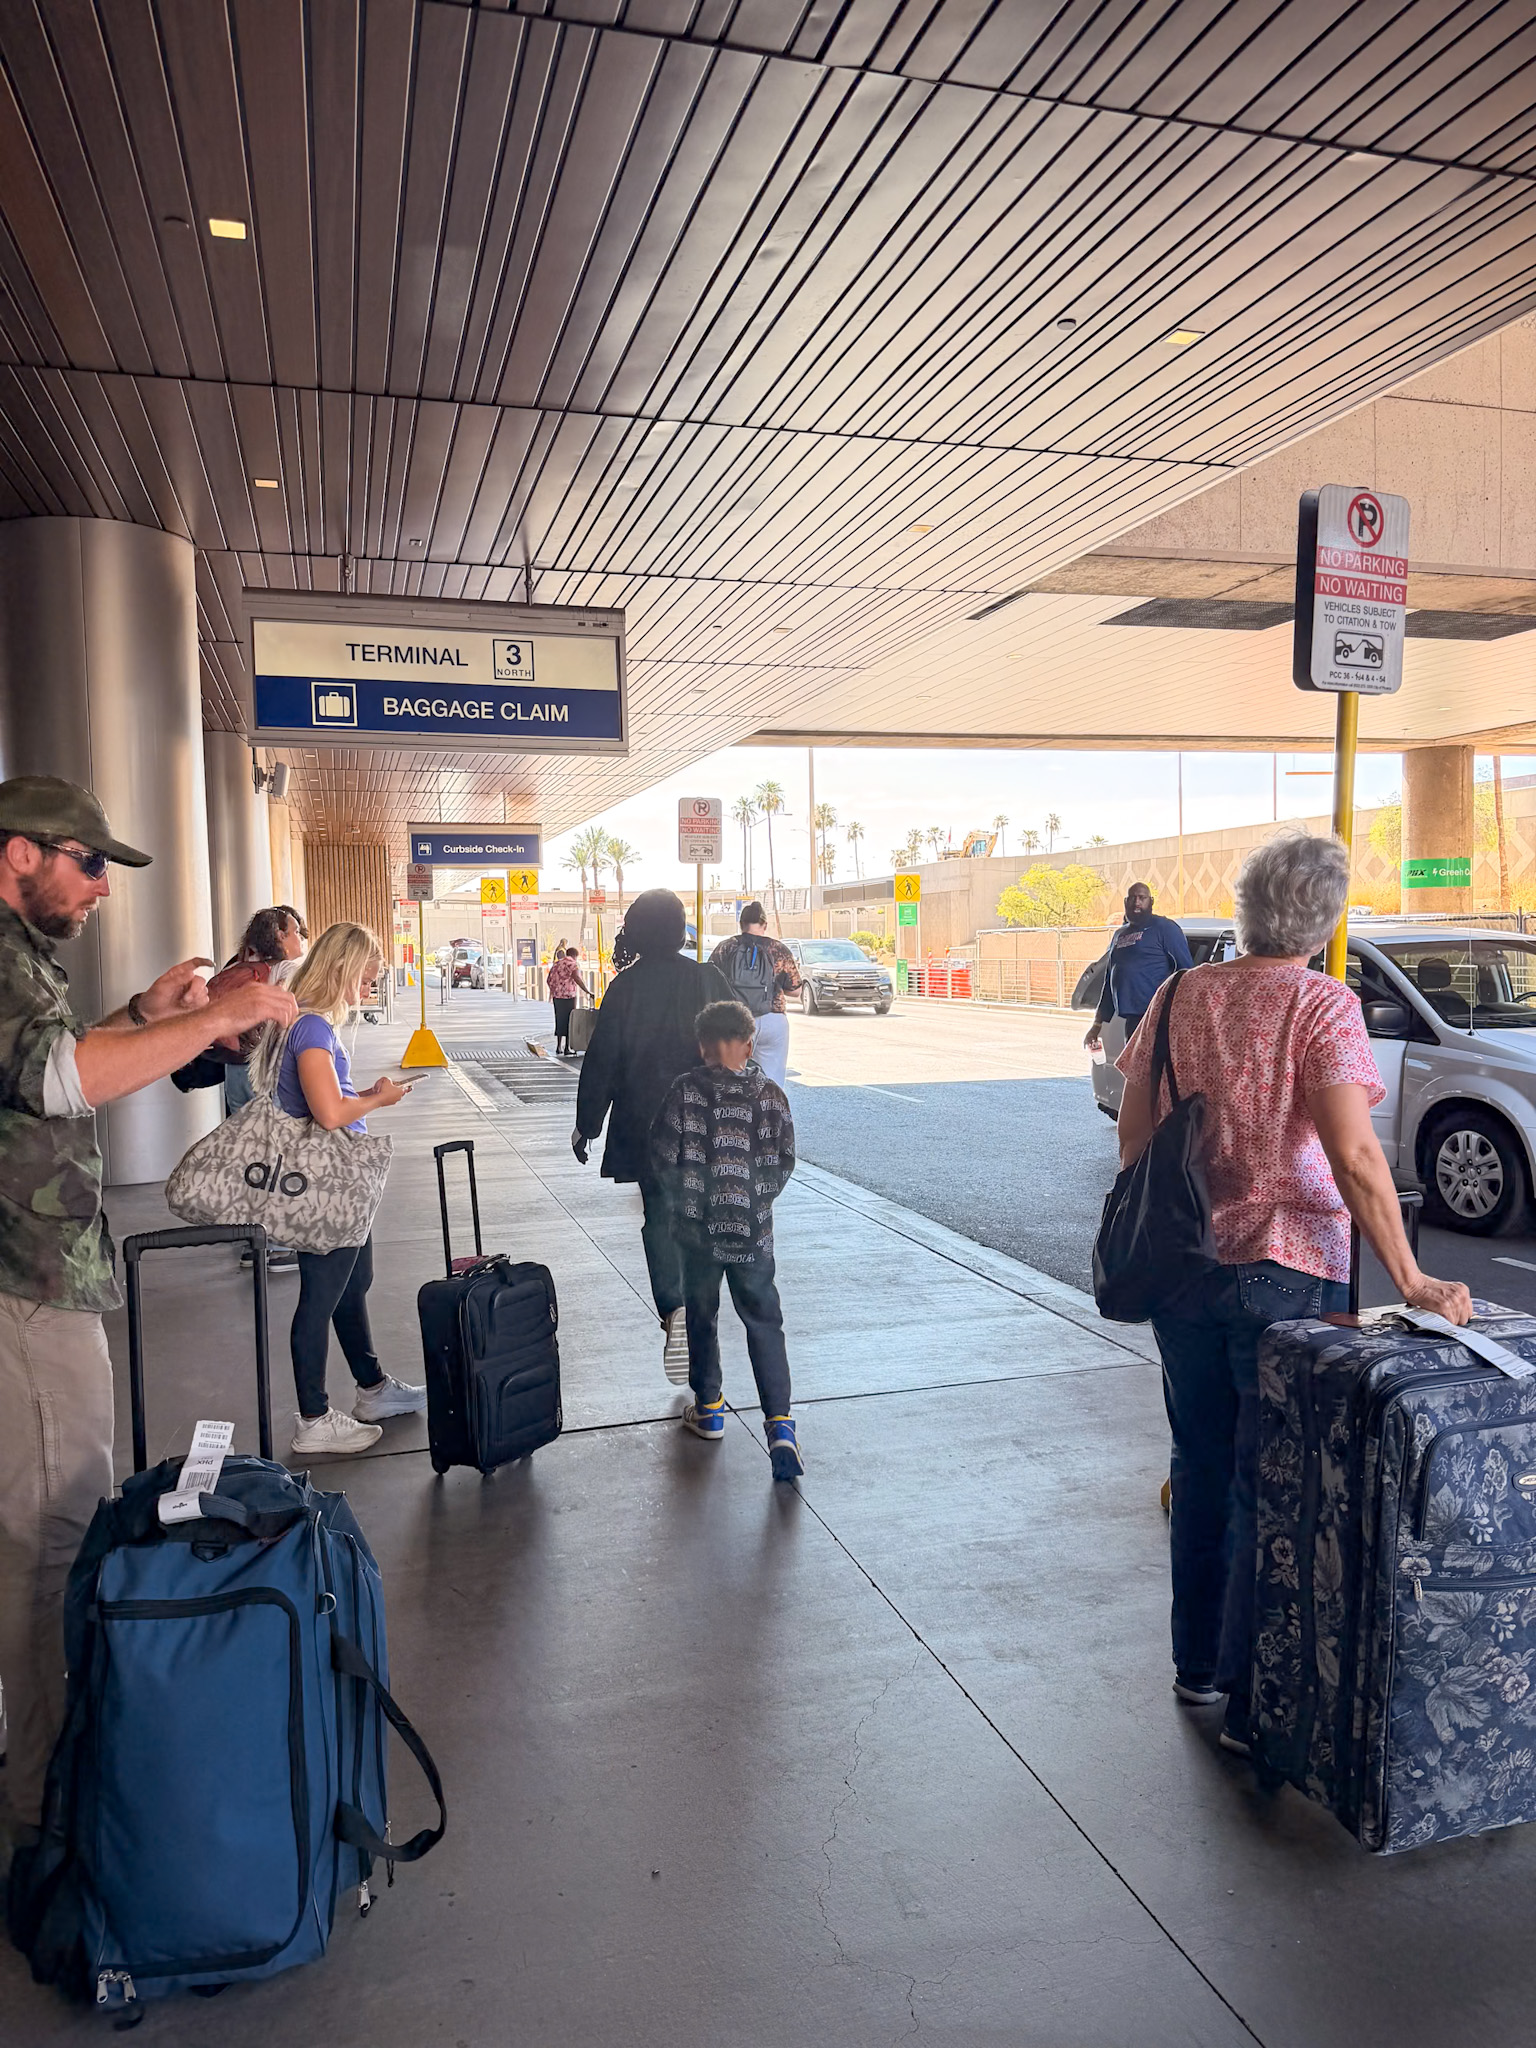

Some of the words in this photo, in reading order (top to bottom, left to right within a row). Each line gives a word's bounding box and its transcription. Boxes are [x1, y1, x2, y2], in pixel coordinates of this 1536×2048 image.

[1320, 549, 1341, 567] NO
[1345, 553, 1404, 576] PARKING
[1320, 576, 1341, 594] NO
[1345, 579, 1403, 602] WAITING
[1324, 601, 1361, 614] VEHICLES
[1363, 606, 1396, 618] SUBJECT
[1324, 614, 1334, 624] TO
[1337, 615, 1370, 628] CITATION
[1372, 620, 1377, 629] &
[1380, 621, 1397, 631] TOW
[345, 643, 469, 667] TERMINAL
[506, 644, 522, 666] 3
[497, 668, 531, 677] NORTH
[1329, 671, 1342, 679] PCC
[383, 697, 495, 720] BAGGAGE
[500, 702, 569, 722] CLAIM
[681, 817, 691, 825] NO
[692, 817, 720, 825] PARKING
[681, 826, 691, 834] NO
[693, 826, 720, 834] WAITING
[443, 844, 484, 854] Curbside
[485, 844, 525, 854] Check-In
[713, 1106, 752, 1123] VIBES
[712, 1134, 750, 1152] VIBES
[244, 1153, 308, 1197] alo
[711, 1163, 750, 1180] VIBES
[710, 1192, 750, 1209] VIBES
[708, 1221, 751, 1238] VIBES
